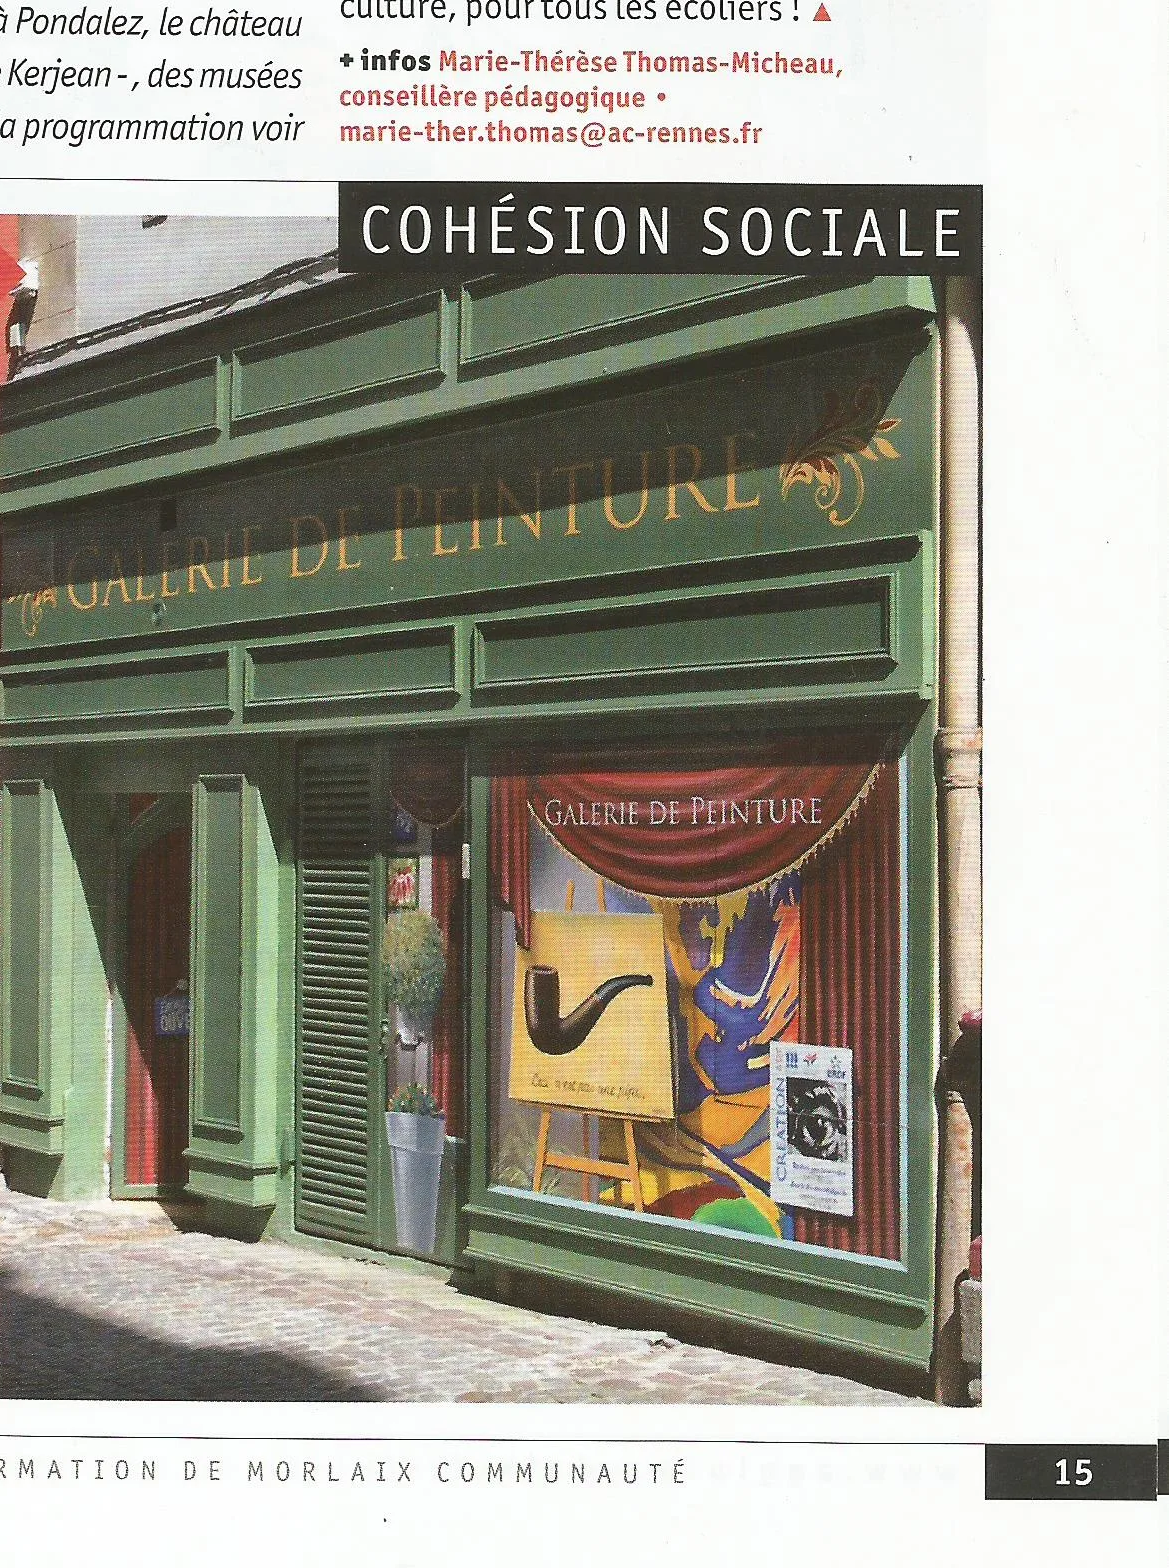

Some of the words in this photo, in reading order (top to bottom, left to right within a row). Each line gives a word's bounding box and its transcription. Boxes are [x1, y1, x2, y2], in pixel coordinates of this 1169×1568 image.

[360, 47, 431, 72] infos
[439, 49, 618, 73] Marie-Thérèse
[622, 50, 843, 78] Thomas-Micheau,
[339, 83, 478, 107] conseillère
[484, 83, 646, 114] pédagogique
[340, 119, 763, 148] marie-ther.thomas@ac-rennes.fr
[362, 192, 668, 256] COHÉSION
[701, 206, 960, 257] SOCIALE
[64, 526, 264, 611] GALERIE
[289, 507, 363, 580] DE
[391, 432, 761, 562] PEINTURE
[544, 799, 639, 826] GALERIE
[649, 800, 680, 825] DE
[691, 796, 823, 825] PEINTURE
[184, 1460, 221, 1481] DE
[247, 1460, 411, 1482] MORLAIX
[437, 1458, 685, 1485] COMMUNAUTÉ
[1055, 1458, 1093, 1486] 15
